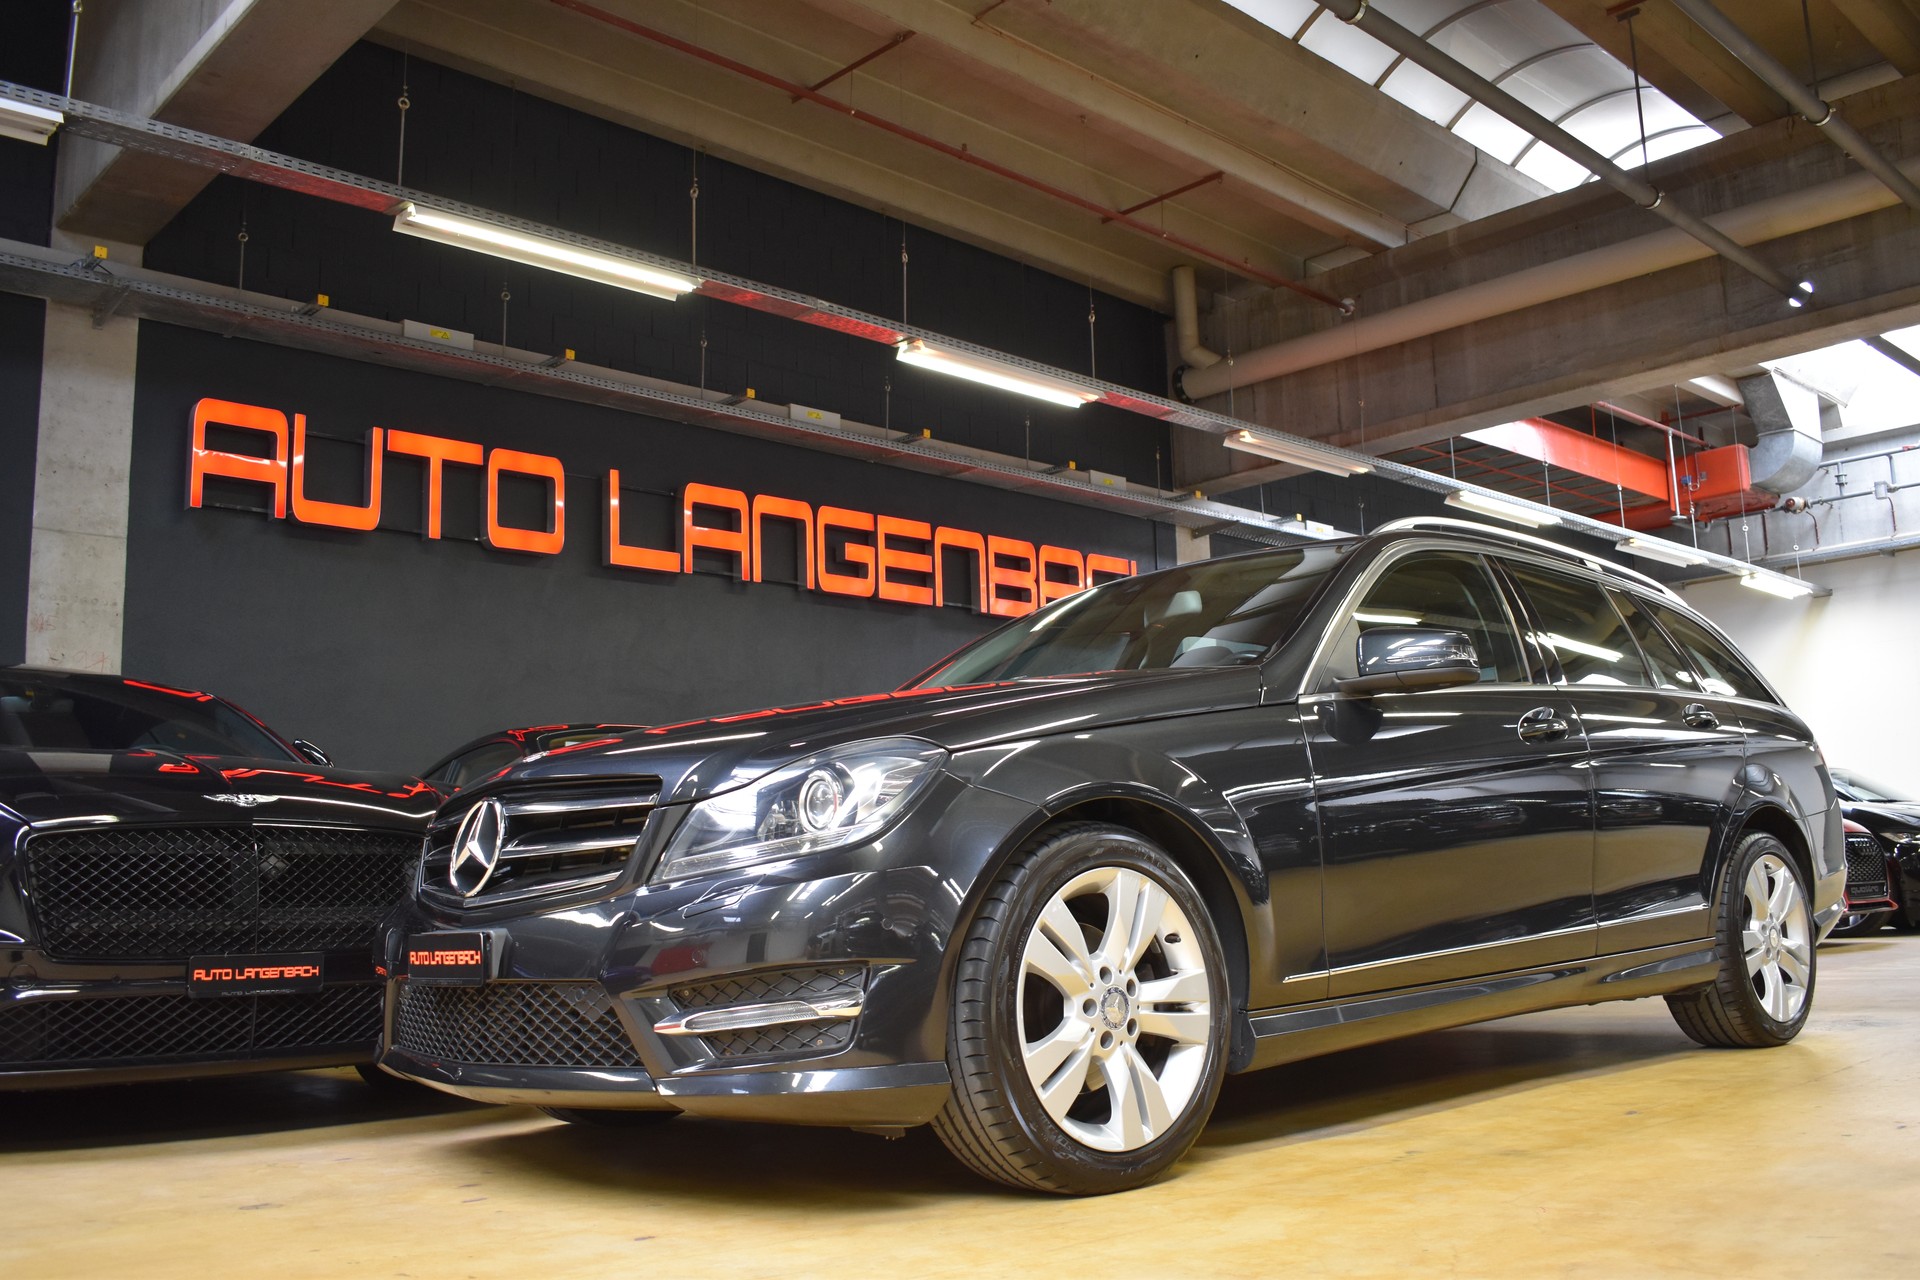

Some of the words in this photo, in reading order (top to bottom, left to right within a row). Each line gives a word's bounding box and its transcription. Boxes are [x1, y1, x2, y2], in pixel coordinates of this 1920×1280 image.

[191, 398, 564, 554] AUTO
[609, 469, 1138, 618] LANGENBA
[409, 951, 429, 966] AUTO
[429, 950, 481, 966] LANGENBACH
[194, 969, 232, 980] AUTO
[236, 966, 319, 979] LANGENBACH
